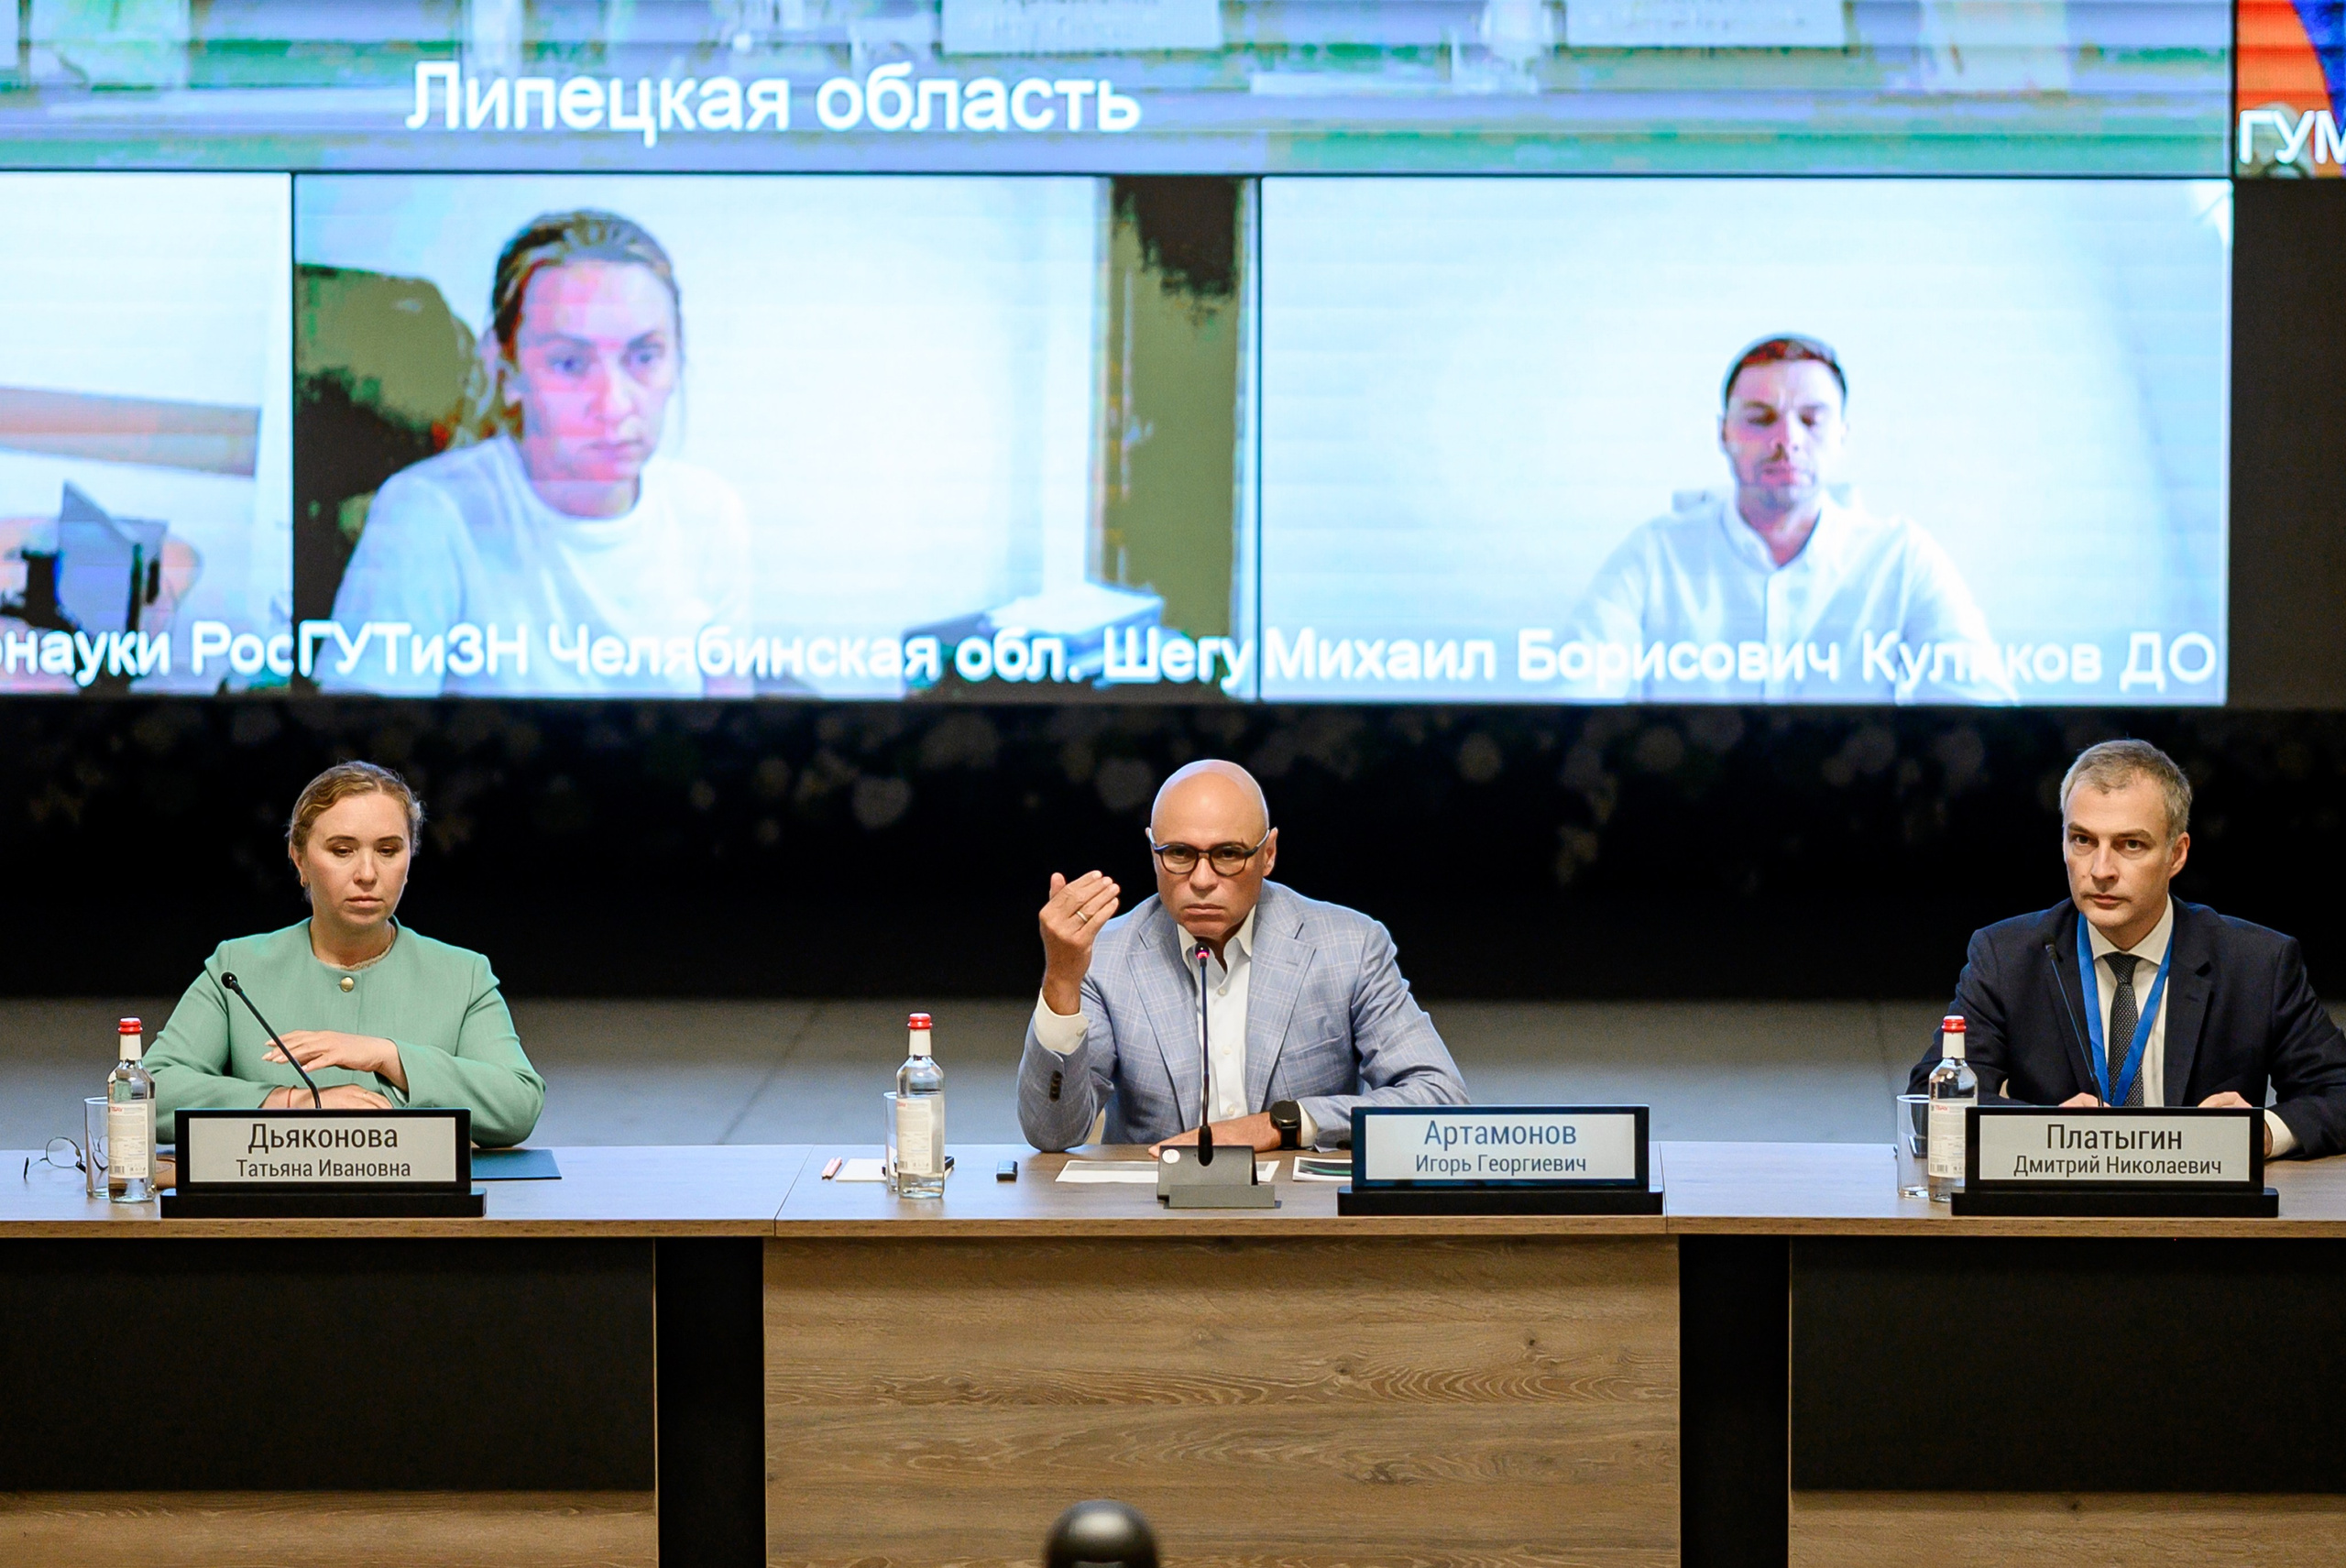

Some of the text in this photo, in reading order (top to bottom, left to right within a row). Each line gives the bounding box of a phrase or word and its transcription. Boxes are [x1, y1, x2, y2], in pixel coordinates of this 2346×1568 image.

[406, 60, 1142, 148] Липецкая область
[0, 620, 293, 686] науки Рос
[299, 620, 1254, 694] ГУТиЗН Челябинская обл. Шегу
[1265, 626, 1496, 680] Михаил
[1518, 629, 1840, 690] Борисович
[2119, 631, 2218, 694] ДО
[247, 1124, 398, 1154] Дьяконова
[1423, 1120, 1577, 1150] Артамонов
[2047, 1124, 2182, 1149] Платыгин
[236, 1159, 411, 1178] Татьяна Ивановна
[1416, 1155, 1586, 1176] Игорь Георгиевич
[2013, 1156, 2221, 1178] Дмитрий Николаевич
